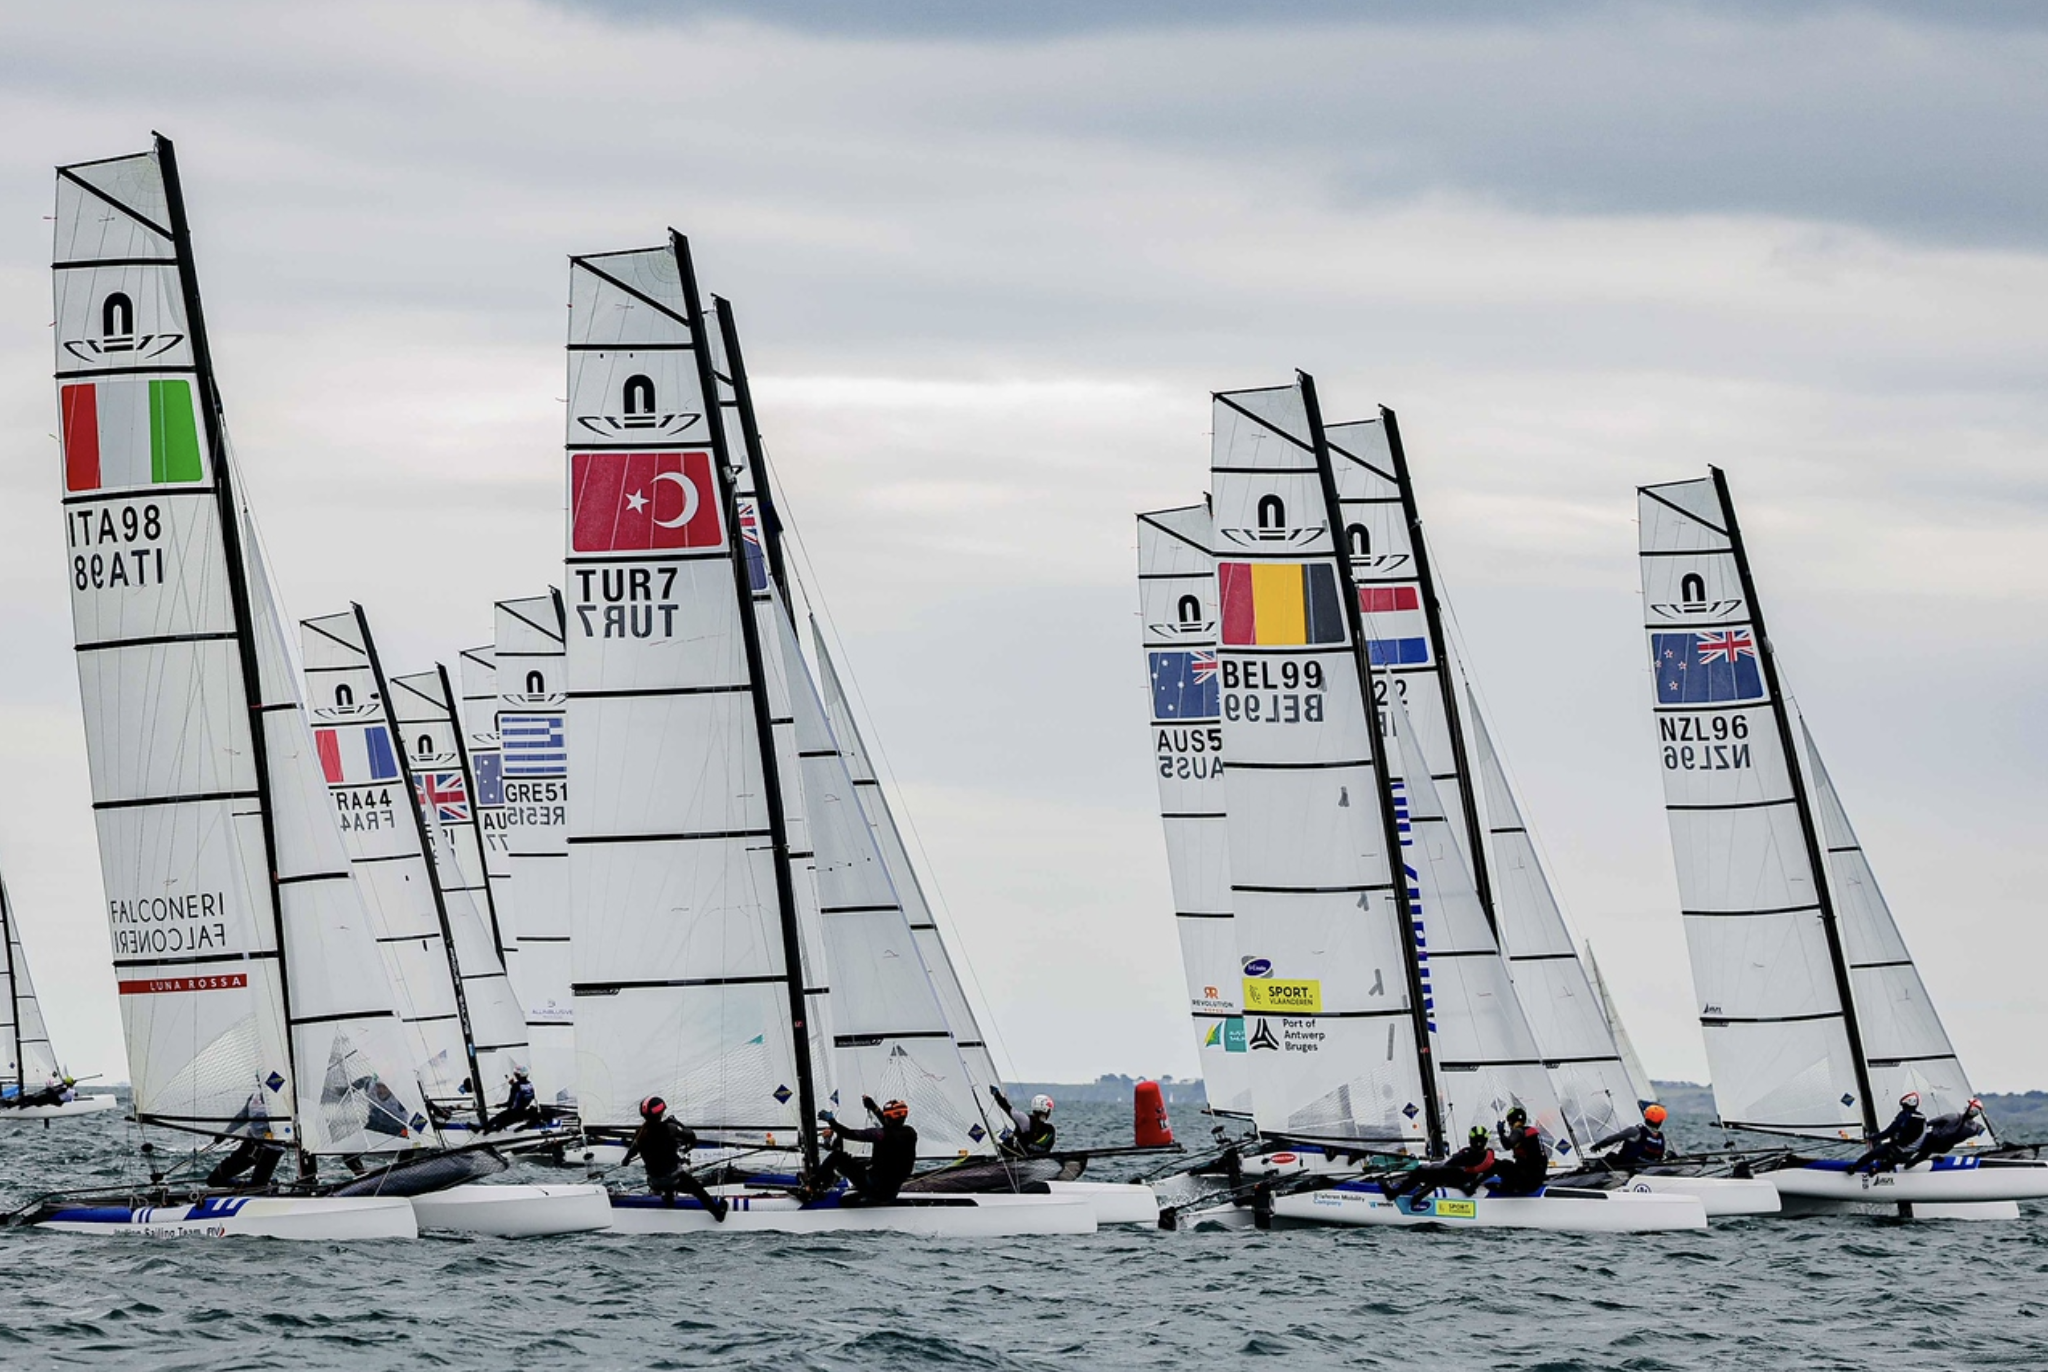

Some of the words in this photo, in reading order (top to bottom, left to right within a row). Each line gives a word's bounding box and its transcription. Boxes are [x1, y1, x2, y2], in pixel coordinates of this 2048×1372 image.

[68, 504, 162, 547] ITA98
[575, 567, 678, 602] TUR7
[1222, 660, 1323, 690] BEL99
[1659, 714, 1749, 742] NZL96
[1157, 728, 1223, 753] AUS5
[330, 788, 392, 811] RA44
[505, 782, 568, 803] GRE51
[109, 891, 225, 923] FALCONERI
[149, 980, 182, 991] LUNA
[188, 976, 241, 989] ROSSA
[1191, 1000, 1235, 1008] REVOLUTION
[1283, 1019, 1303, 1028] Port
[1305, 1019, 1316, 1028] of
[1284, 1030, 1326, 1041] Antwerp
[1285, 1041, 1318, 1053] Bruges
